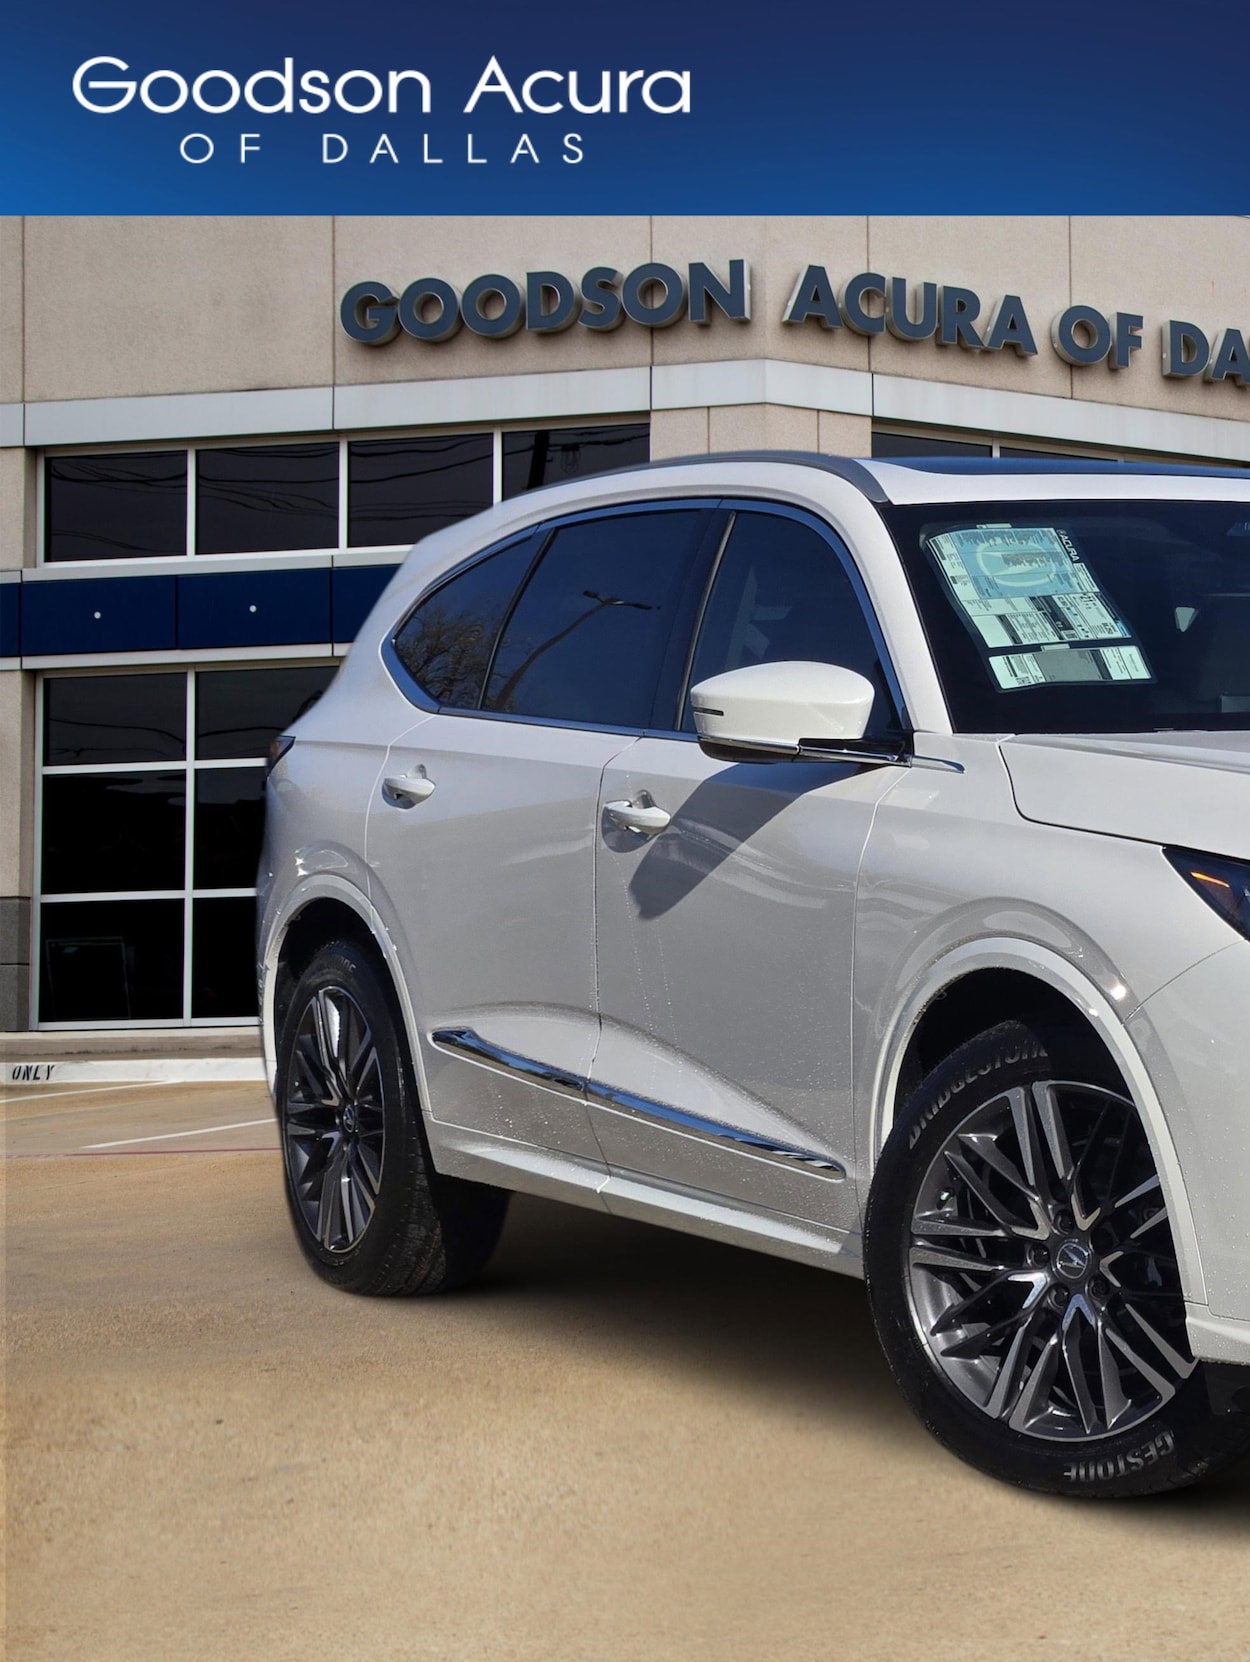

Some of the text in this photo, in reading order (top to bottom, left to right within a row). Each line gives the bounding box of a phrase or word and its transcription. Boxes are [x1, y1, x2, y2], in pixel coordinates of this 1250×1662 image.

[341, 259, 751, 347] GOODSON
[783, 265, 1038, 357] ACURA
[1052, 305, 1144, 370] OF
[1060, 533, 1080, 562] ACURA
[12, 1064, 56, 1081] ONLY
